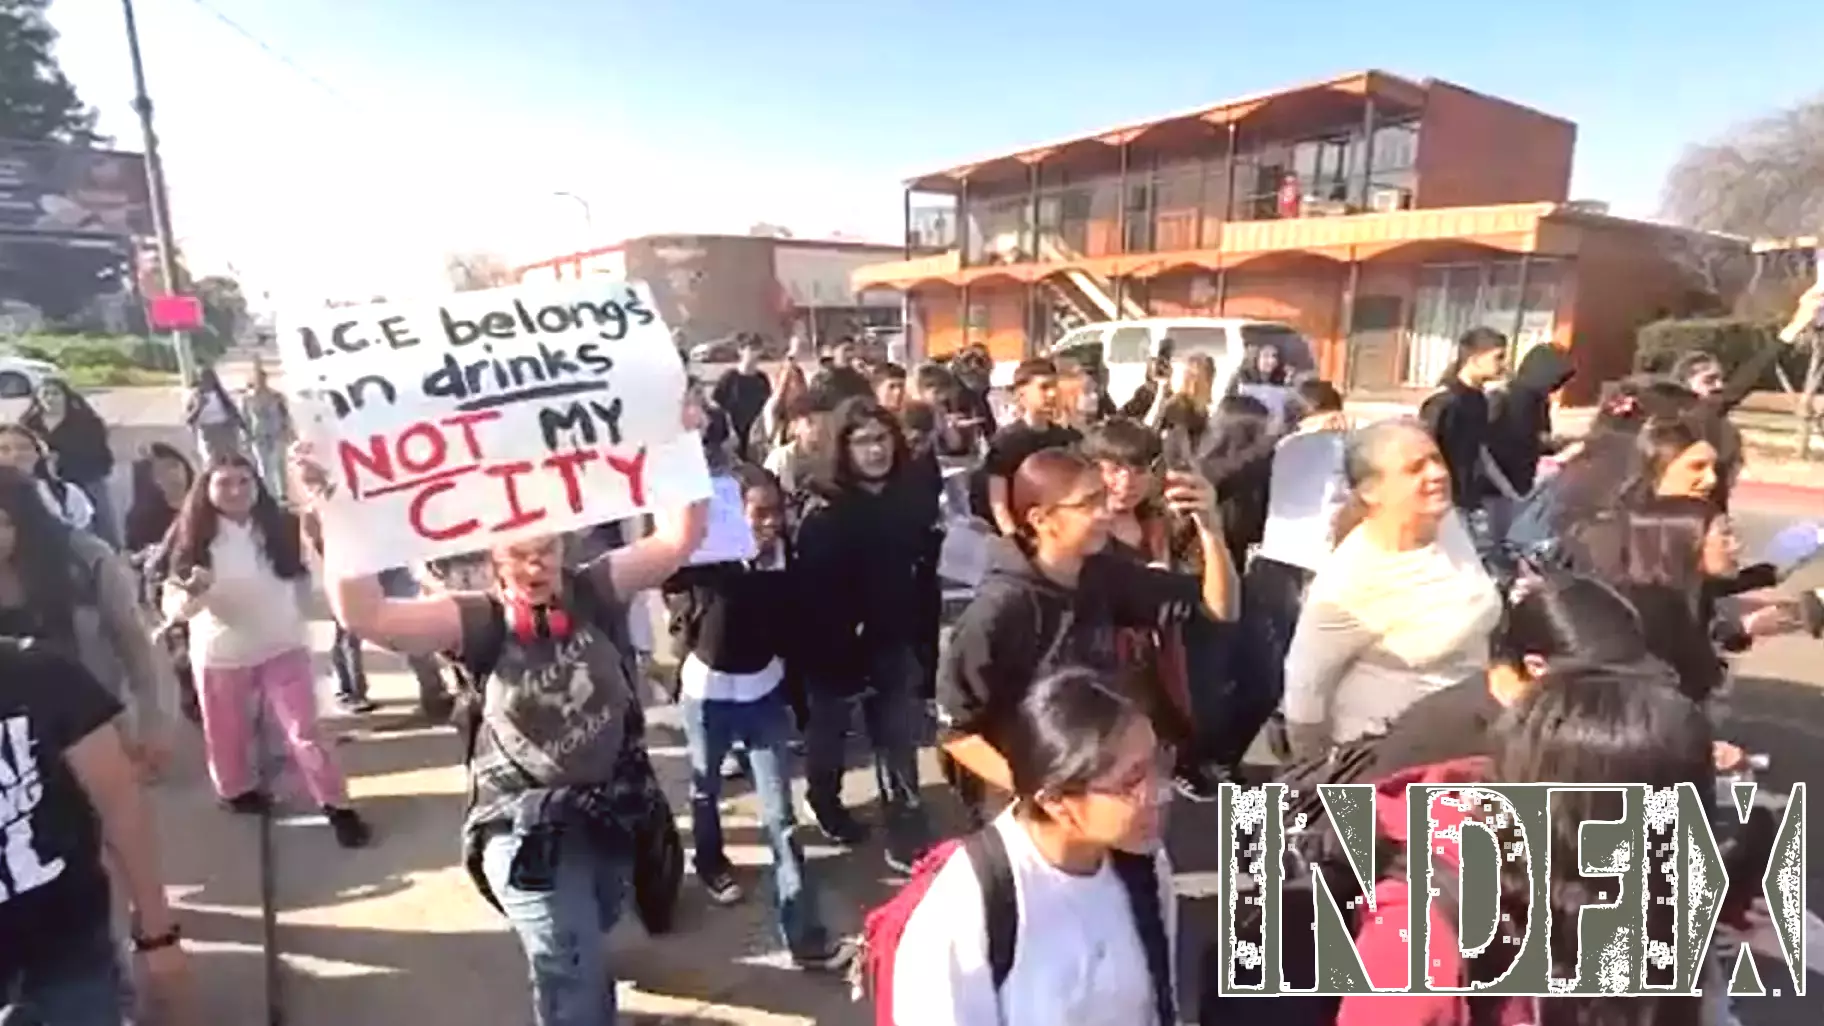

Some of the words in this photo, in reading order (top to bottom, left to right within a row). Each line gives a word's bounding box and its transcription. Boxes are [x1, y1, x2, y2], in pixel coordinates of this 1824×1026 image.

[314, 374, 396, 420] in
[422, 343, 613, 398] drinks
[339, 411, 502, 500] NOT
[539, 399, 622, 451] MY
[409, 447, 647, 541] CITY
